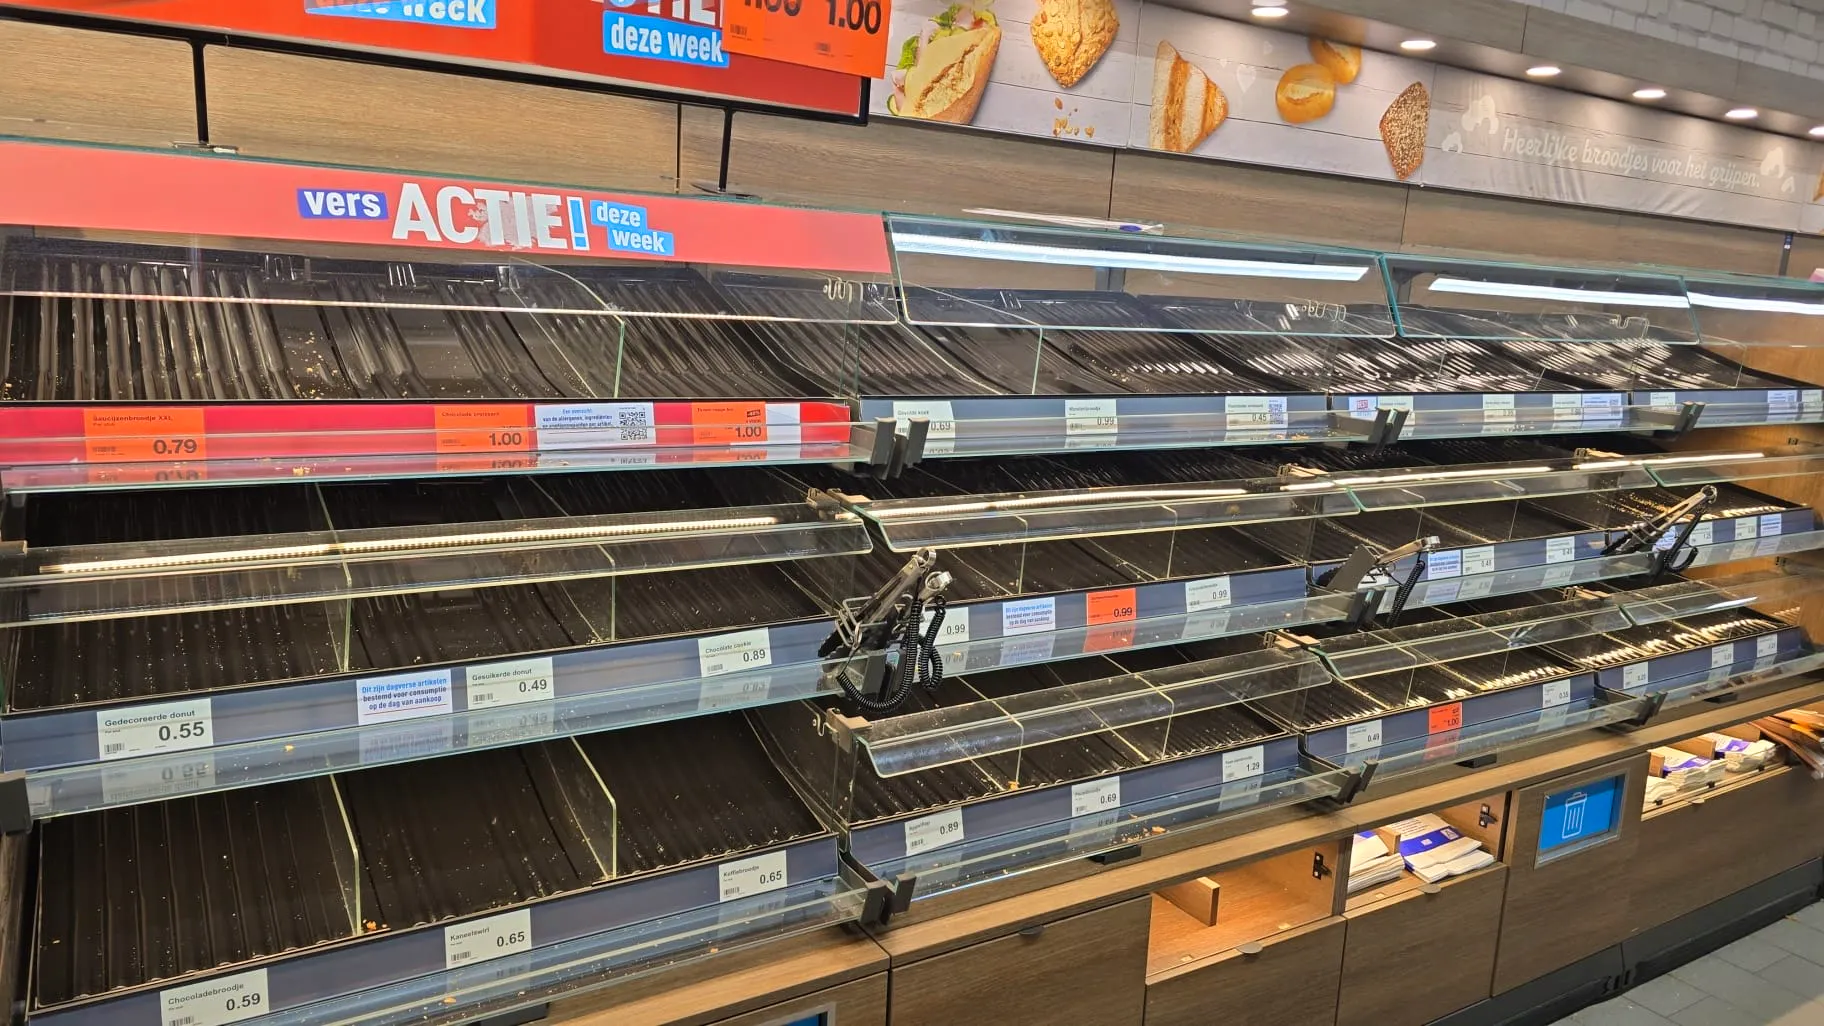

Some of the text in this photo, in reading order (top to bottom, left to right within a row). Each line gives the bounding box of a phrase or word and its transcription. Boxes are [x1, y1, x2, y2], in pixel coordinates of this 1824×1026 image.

[825, 0, 882, 35] 1.00
[611, 17, 724, 63] deze week
[1502, 127, 1761, 192] Heerlijke broodjes voor het grijpen.
[303, 190, 382, 218] vers
[392, 182, 591, 251] ACTIE!
[596, 202, 641, 228] deze
[612, 228, 665, 253] week
[1097, 417, 1115, 427] 0.99
[1252, 413, 1267, 422] 0.45
[736, 427, 761, 438] 1.00
[930, 421, 951, 431] 0.69
[489, 433, 522, 446] 1.00
[153, 439, 198, 455] 0.79
[1213, 590, 1228, 600] 0.99
[1114, 607, 1133, 618] 0.99
[946, 624, 966, 635] 0.99
[743, 649, 766, 662] 0.89
[472, 668, 532, 681] Gesuikerde donut
[362, 677, 447, 693] Dit zijn dagverse artikelen
[519, 679, 547, 693] 0.49
[363, 692, 392, 702] bestemd
[409, 686, 447, 697] consumptie
[378, 701, 387, 709] de
[387, 700, 401, 709] dag
[414, 695, 442, 704] aankoop
[104, 709, 195, 727] Gedecoreerde donut
[158, 721, 205, 741] 0.55
[1246, 761, 1260, 772] 1.29
[1100, 793, 1117, 804] 0.69
[939, 821, 959, 835] 0.89
[759, 870, 782, 884] 0.65
[496, 931, 525, 947] 0.65
[168, 983, 244, 1005] Chocoladebroodje
[226, 992, 261, 1011] 0.59
